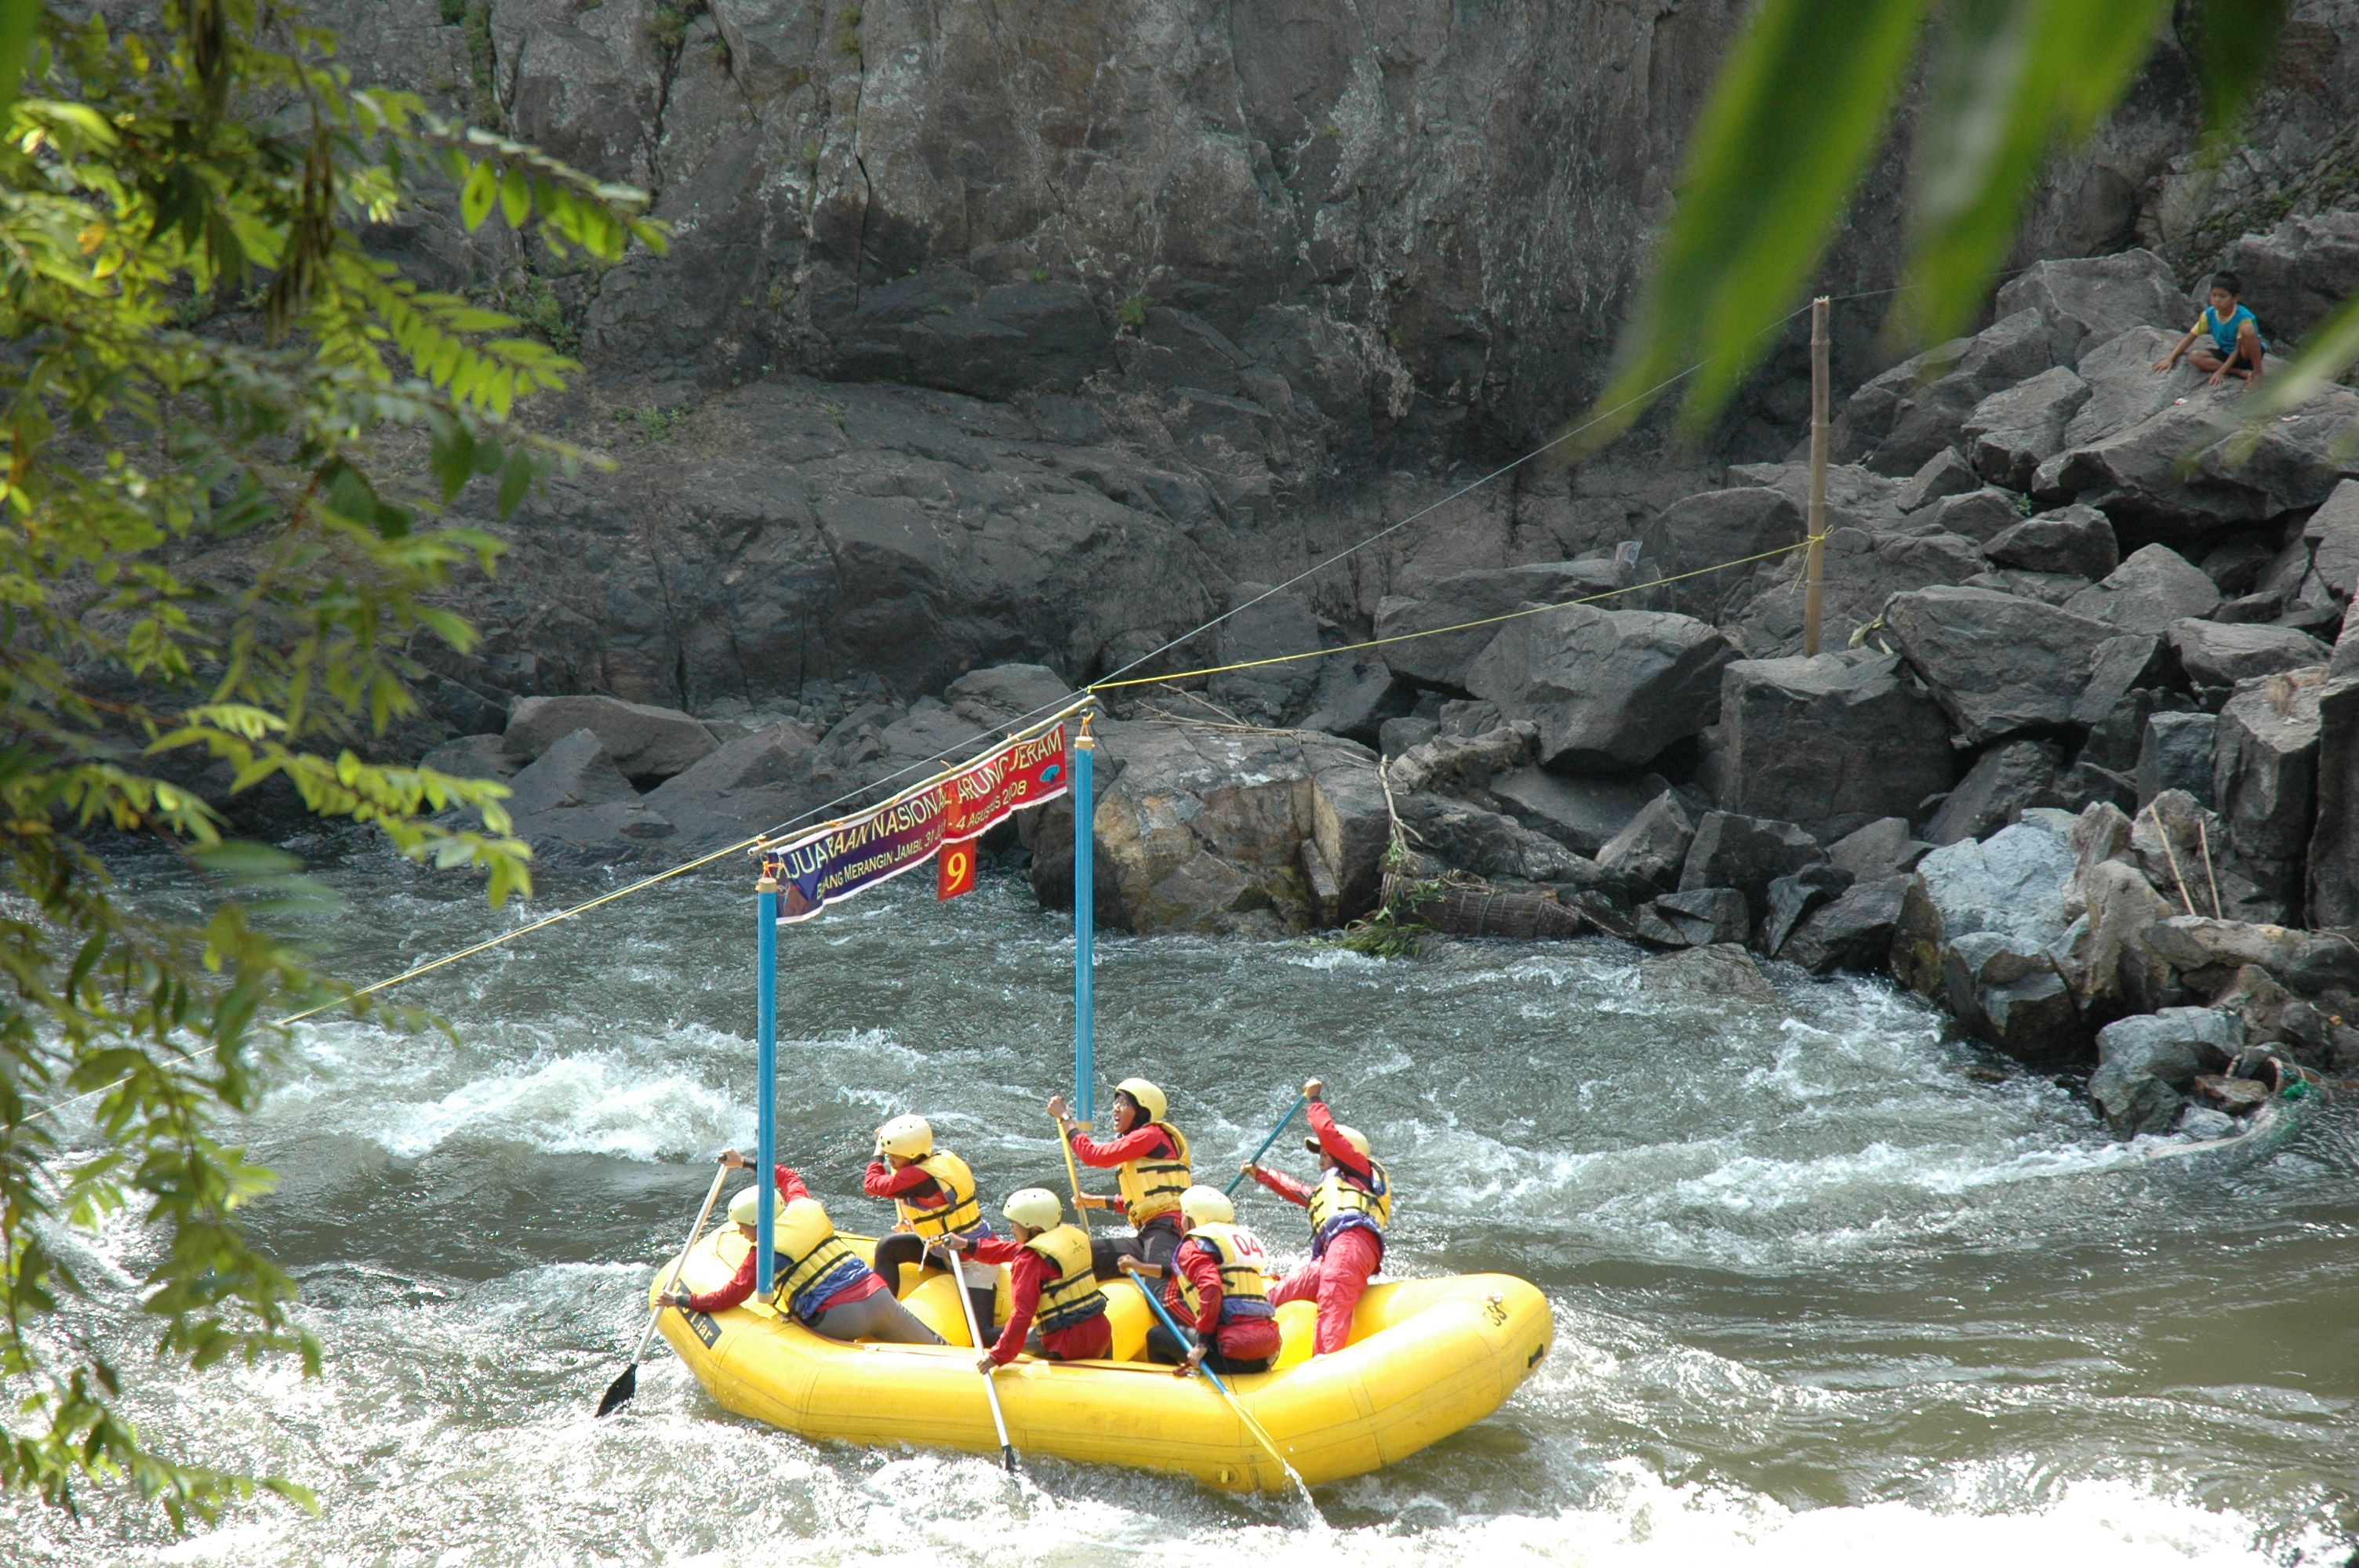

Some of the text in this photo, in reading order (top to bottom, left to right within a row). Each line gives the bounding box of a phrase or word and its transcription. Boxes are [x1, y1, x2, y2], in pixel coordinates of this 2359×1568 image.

[871, 787, 953, 841] NASIONAL
[1009, 728, 1063, 772] JERAM
[844, 850, 894, 883] MERANGIN
[925, 829, 935, 848] 31
[955, 815, 966, 830] 4
[947, 851, 968, 892] 9
[1232, 1233, 1264, 1258] 04
[689, 1312, 714, 1341] Liar
